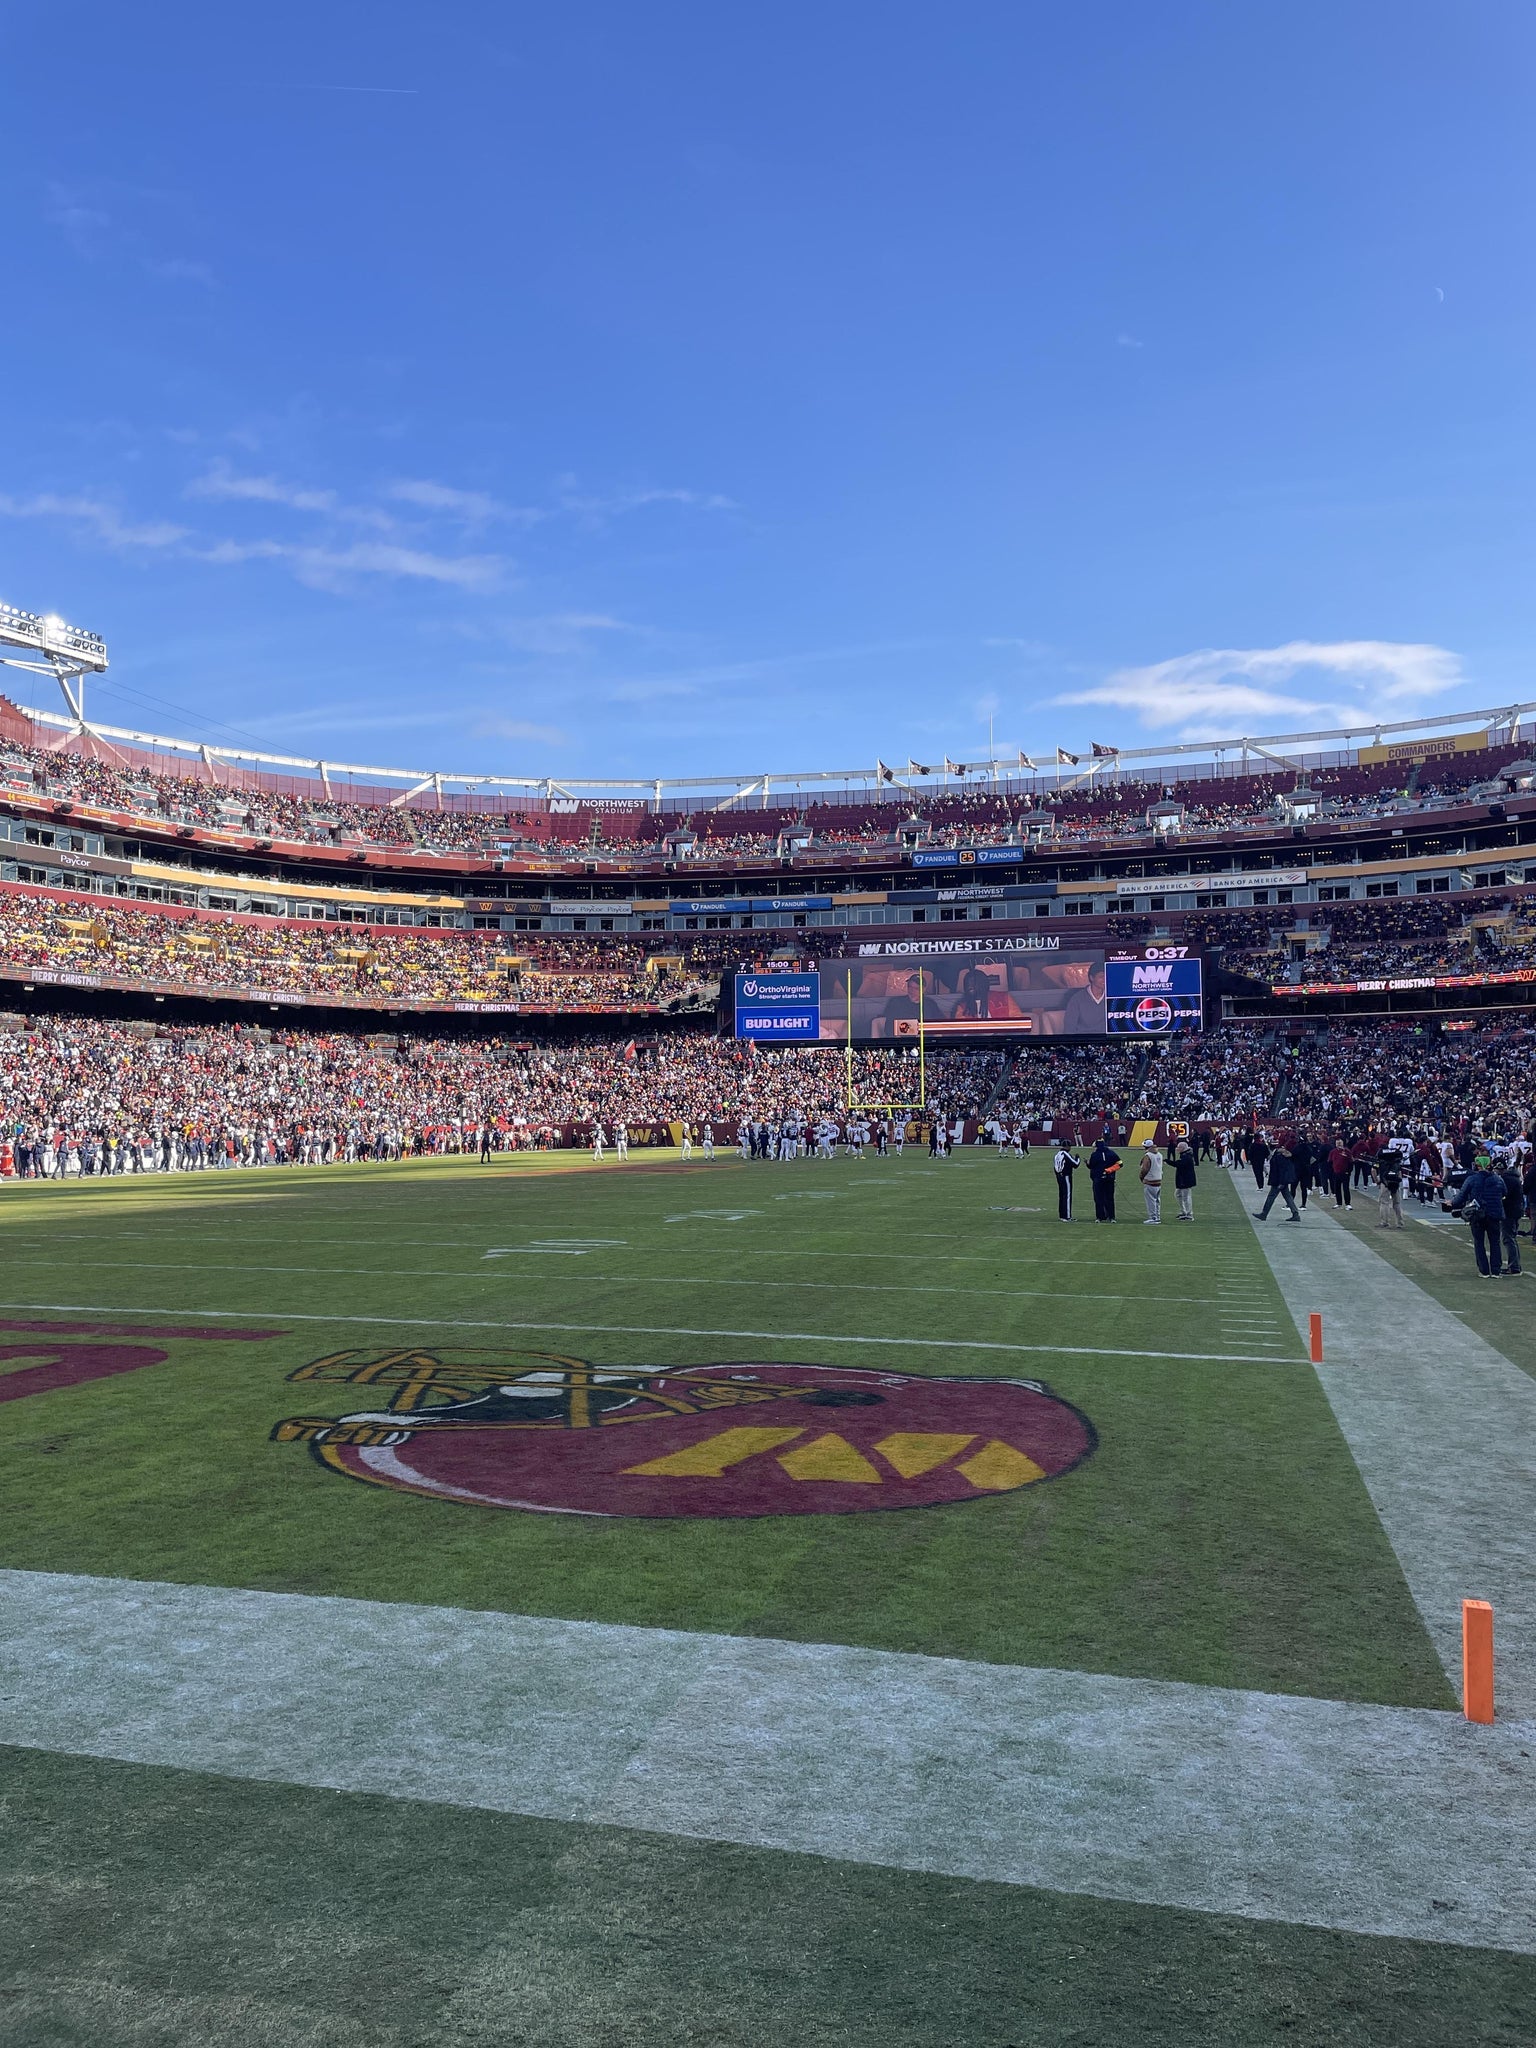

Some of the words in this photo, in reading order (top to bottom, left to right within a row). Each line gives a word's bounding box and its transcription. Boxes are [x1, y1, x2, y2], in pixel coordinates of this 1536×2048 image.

[1388, 740, 1455, 759] COMMANDERS
[550, 800, 580, 813] NW
[582, 800, 646, 808] NORTHWEST
[60, 854, 91, 867] Paycor
[961, 853, 974, 862] 25
[989, 851, 1022, 859] FANDUEL
[937, 891, 956, 900] NW
[859, 943, 881, 955] NW
[885, 940, 982, 954] NORTHWEST
[985, 937, 1060, 950] STADIUM
[1145, 947, 1188, 959] 0:37
[32, 971, 58, 982] MERRY
[61, 974, 101, 986] CHRISTMAS
[1132, 965, 1173, 983] NW
[1357, 980, 1386, 991] MERRY
[1389, 978, 1436, 990] CHRISTMAS
[250, 991, 271, 1001] MERRY
[273, 994, 306, 1003] CHRISTMAS
[455, 1003, 478, 1011] MERRY
[481, 1004, 520, 1012] CHRISTMAS
[746, 1019, 771, 1028] BUD
[773, 1018, 809, 1028] LIGHT
[664, 1209, 765, 1223] 20
[480, 1239, 628, 1260] 10
